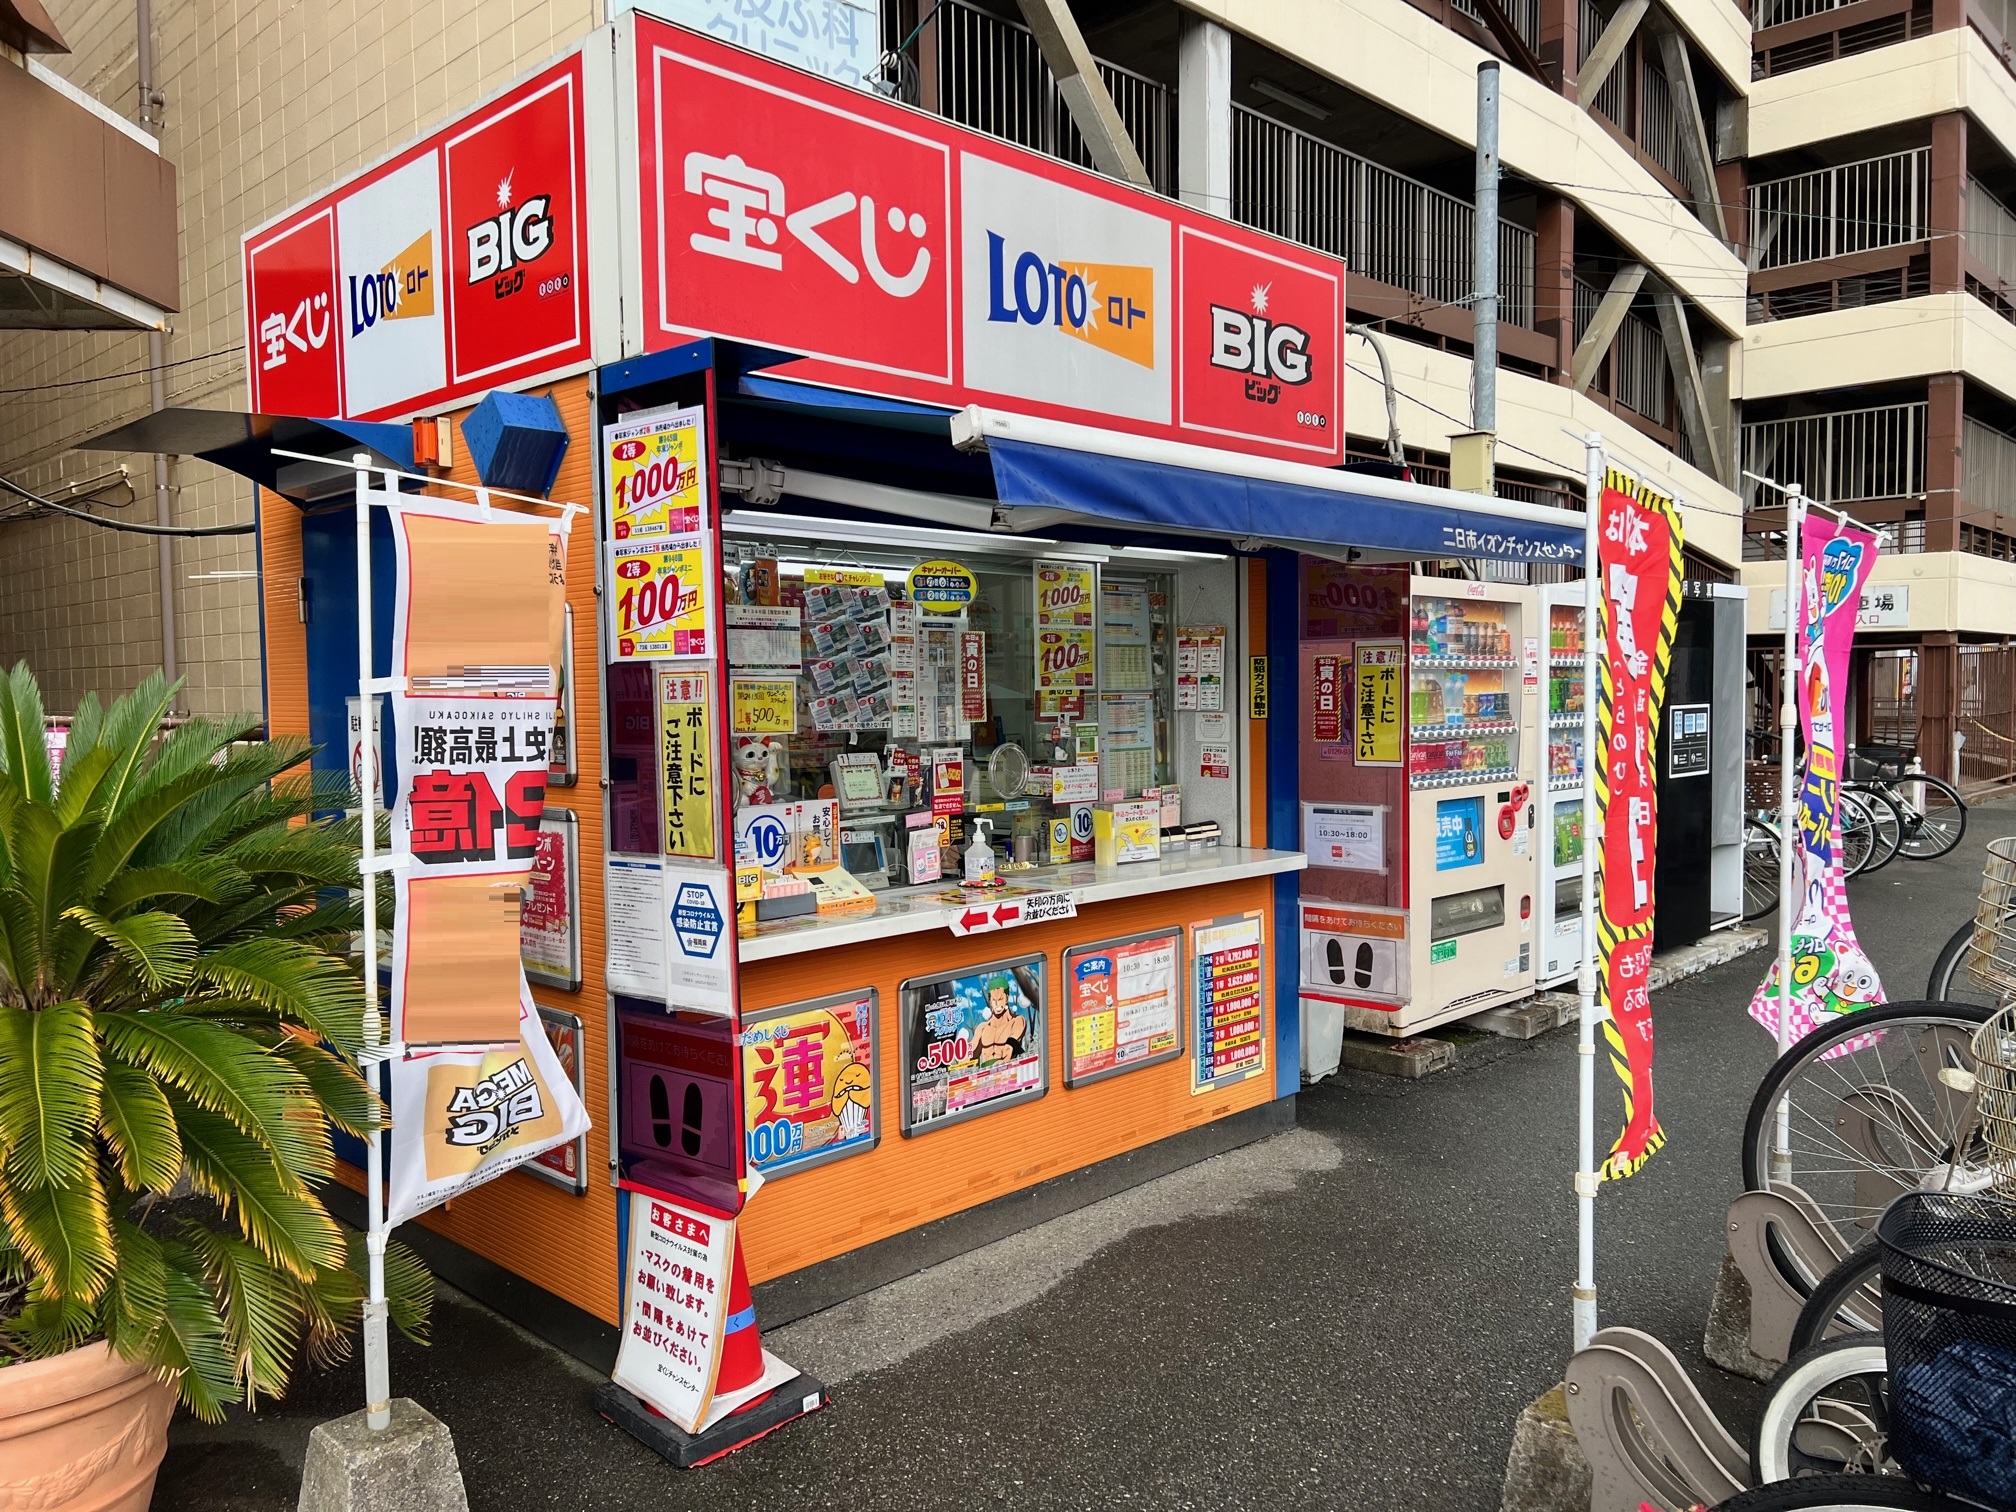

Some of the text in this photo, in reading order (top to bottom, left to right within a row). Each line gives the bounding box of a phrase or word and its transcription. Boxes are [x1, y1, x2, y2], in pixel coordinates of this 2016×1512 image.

[467, 194, 554, 287] BIG
[684, 152, 931, 298] 宝くじ
[406, 264, 430, 295] ロト
[494, 268, 526, 300] ビッグ
[986, 229, 1087, 329] LOTO
[348, 271, 397, 339] LOTO
[1107, 295, 1146, 330] ロト
[260, 291, 331, 371] 宝くじ
[1210, 303, 1312, 386] BIG
[1244, 378, 1281, 405] ビッグ
[622, 443, 637, 460] 2等
[615, 456, 696, 510] 1,000万円
[1442, 526, 1583, 559] 二日市イオンチャンスセンター
[626, 562, 641, 577] 2等
[618, 574, 698, 631] 100万円
[1855, 613, 1880, 625] 入口
[966, 642, 980, 688] 寅の日
[1040, 643, 1090, 673] 100万円
[1362, 651, 1397, 664] 注意!!
[666, 679, 703, 700] 注意!!
[1253, 658, 1266, 717] 防犯カメラ作動中
[1320, 666, 1334, 711] 寅の日
[1380, 667, 1395, 723] ボードに
[1360, 675, 1375, 757] ご注意下さい
[686, 706, 706, 796] ボードに
[665, 718, 686, 850] ご注意下さい
[752, 824, 791, 858] 10万円
[822, 807, 831, 848] 安心して
[686, 890, 705, 900] STOP
[737, 874, 758, 884] BIG
[677, 908, 716, 920] 新型コロナウイルス
[1024, 904, 1071, 921] お並びください
[1026, 892, 1071, 909] 矢印の方向に
[676, 917, 719, 932] 感染防止宣言
[1304, 914, 1402, 932] 間隔をあけてお待ちください
[1083, 959, 1106, 973] ご案内
[1079, 978, 1109, 998] 宝くじ
[753, 1020, 833, 1129] 運
[746, 1117, 804, 1164] 00万円
[651, 1207, 709, 1242] お客さまへ
[650, 1230, 708, 1263] 新型コロナウイルス対策の為
[637, 1269, 709, 1318] お願い致します。
[632, 1320, 702, 1374] お並びください。
[656, 1364, 700, 1394] 宝くじチャンスセンター
